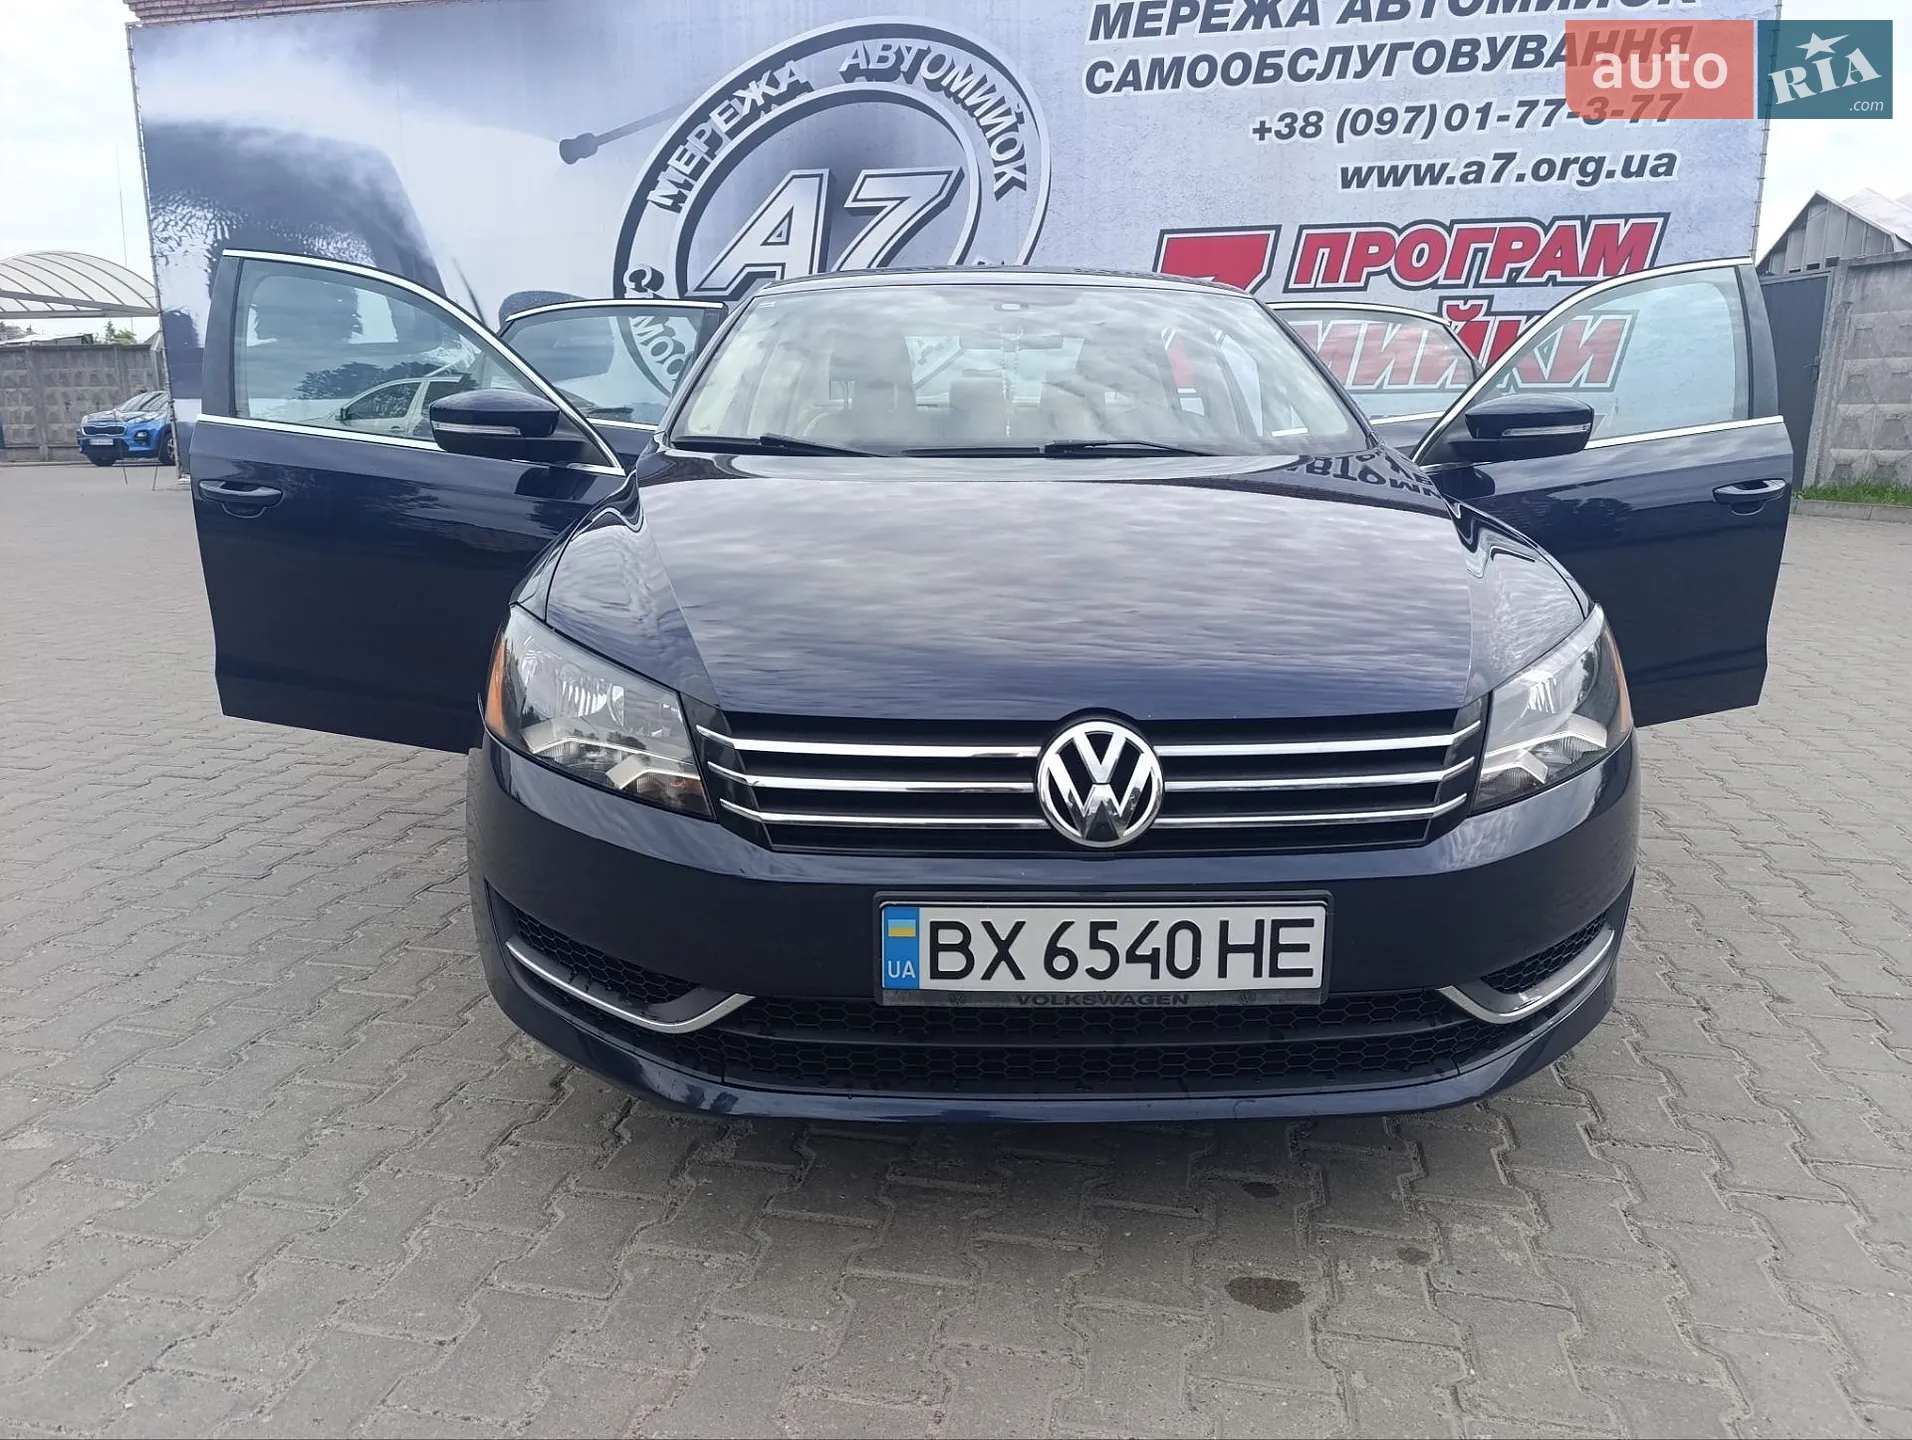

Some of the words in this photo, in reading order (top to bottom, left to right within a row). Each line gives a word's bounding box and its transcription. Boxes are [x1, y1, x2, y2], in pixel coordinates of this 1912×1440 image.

[1089, 0, 1312, 41] МЕРЕЖА
[1086, 26, 1693, 94] САМООБСЛУГОВУВАННЯ
[647, 59, 811, 210] МЕРЕЖА
[838, 41, 1027, 202] АВТОМИЙОК
[1252, 110, 1325, 142] +38
[1340, 151, 1677, 189] www.a7.org.ua
[1286, 214, 1667, 292] ПРОГРАМ
[888, 961, 916, 979] UA
[928, 919, 1027, 981] BX
[1043, 919, 1203, 981] 6540
[1217, 918, 1315, 979] HE
[1015, 993, 1190, 1007] VOLKSWAGEN
